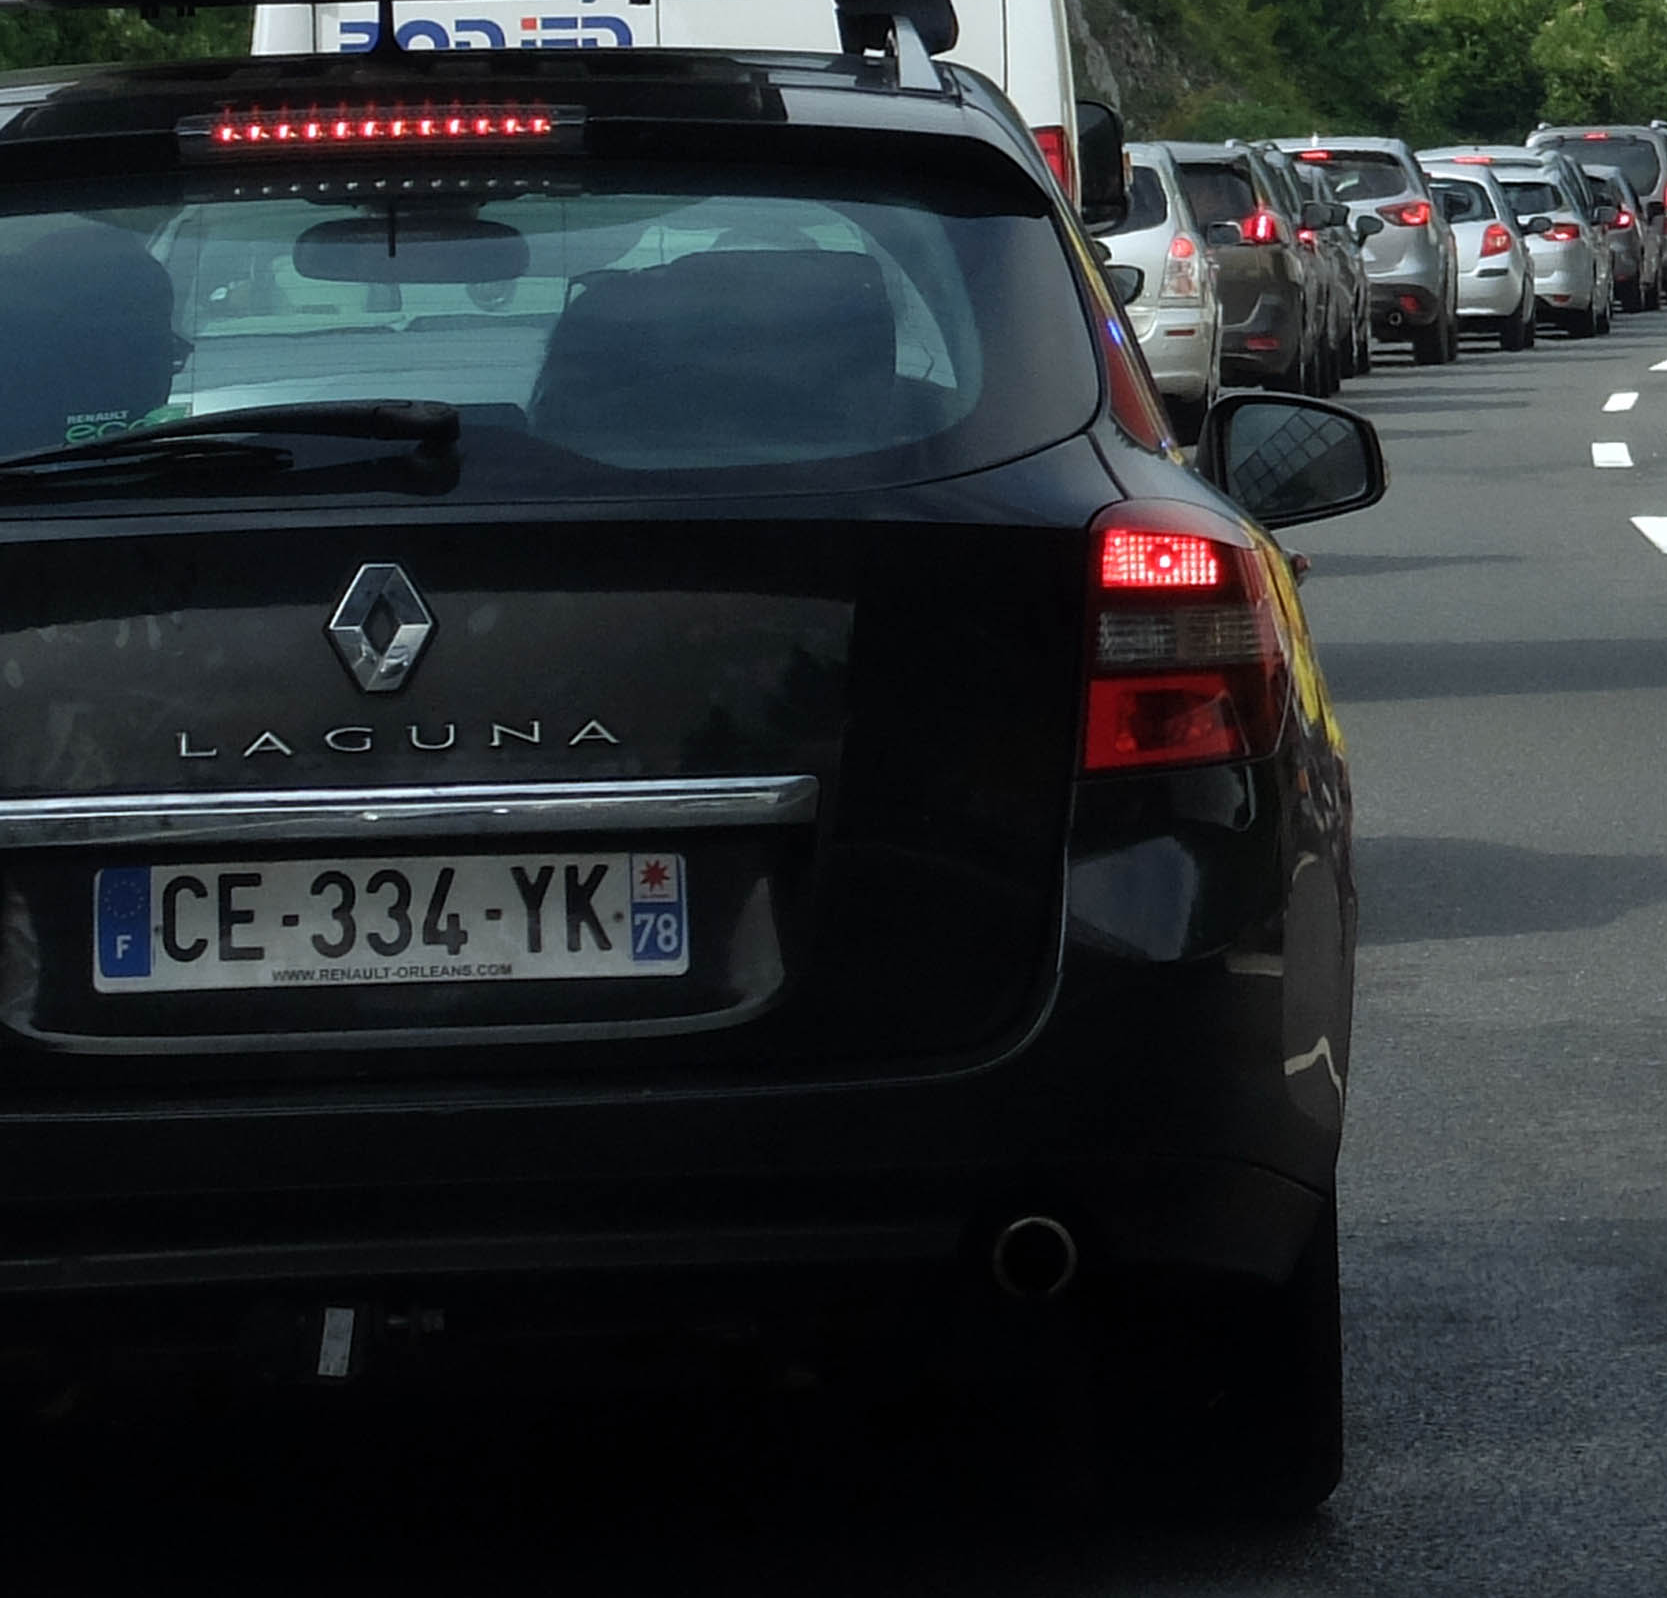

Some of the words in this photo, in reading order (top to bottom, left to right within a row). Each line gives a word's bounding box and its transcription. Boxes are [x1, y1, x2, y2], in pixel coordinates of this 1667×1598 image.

[66, 410, 129, 424] RENAULT
[176, 720, 620, 758] LAGUNA
[116, 935, 132, 960] F
[162, 864, 613, 963] CE-334-YK
[633, 913, 679, 953] 78
[272, 964, 512, 982] WWW.RENAULT-ORLEANS.COM
